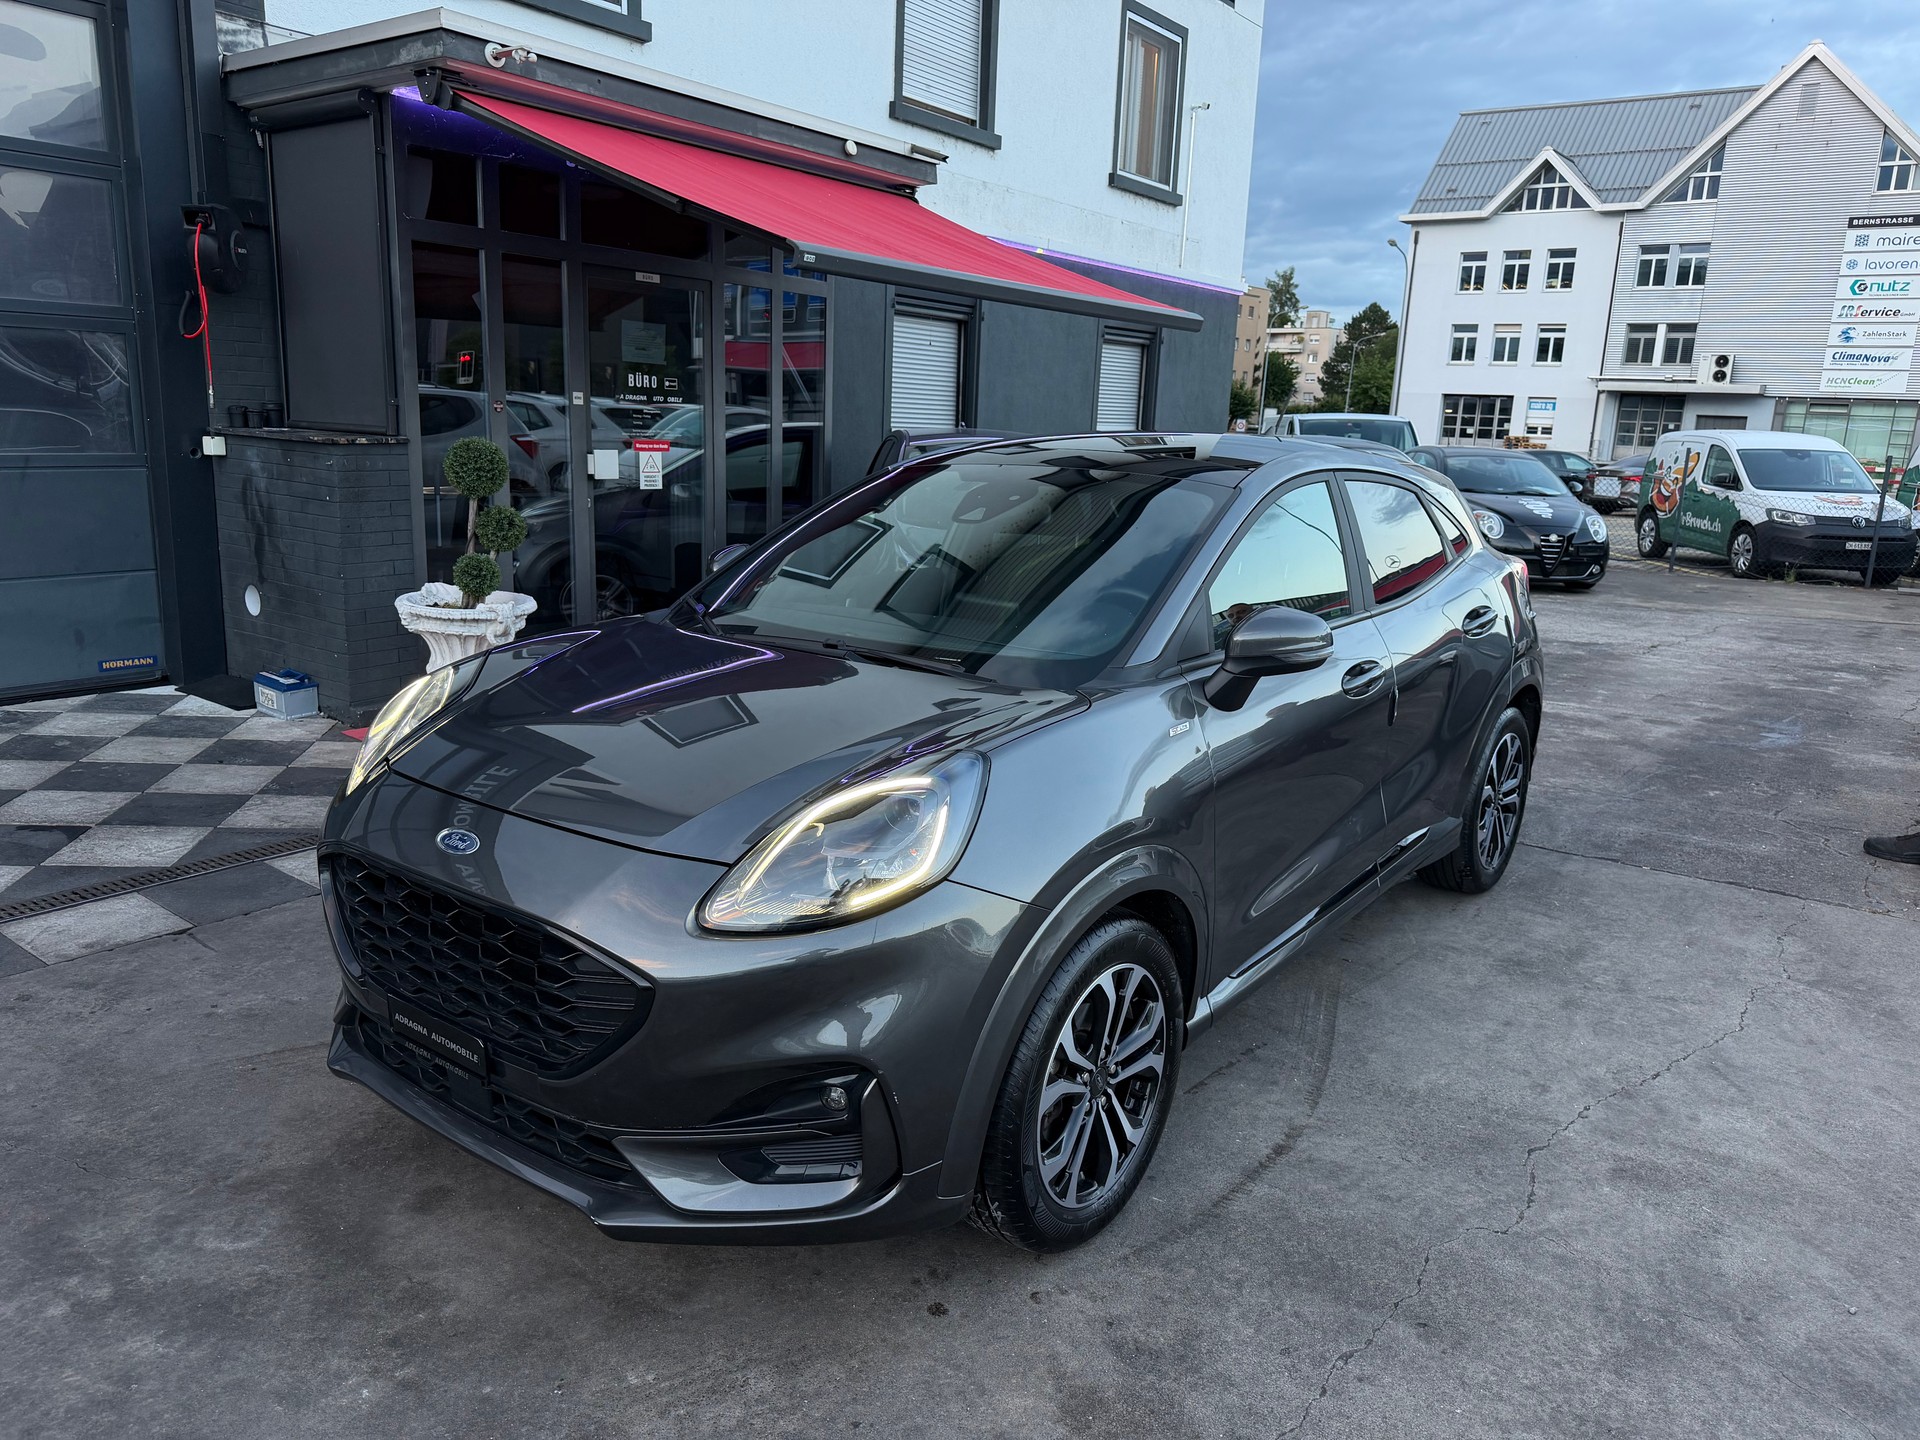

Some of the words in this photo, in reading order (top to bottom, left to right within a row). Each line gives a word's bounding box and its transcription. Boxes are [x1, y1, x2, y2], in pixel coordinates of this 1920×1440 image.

[1852, 216, 1914, 225] BERNSTRASSE
[1865, 258, 1920, 270] lavoren
[1869, 279, 1911, 292] nutz
[1832, 351, 1891, 362] ClimaNova
[628, 372, 657, 388] BÜRO
[1826, 377, 1875, 385] HCNClean
[444, 833, 470, 850] Ford
[394, 1013, 428, 1036] ADRAGNA
[431, 1032, 479, 1063] AUTOMOBILE
